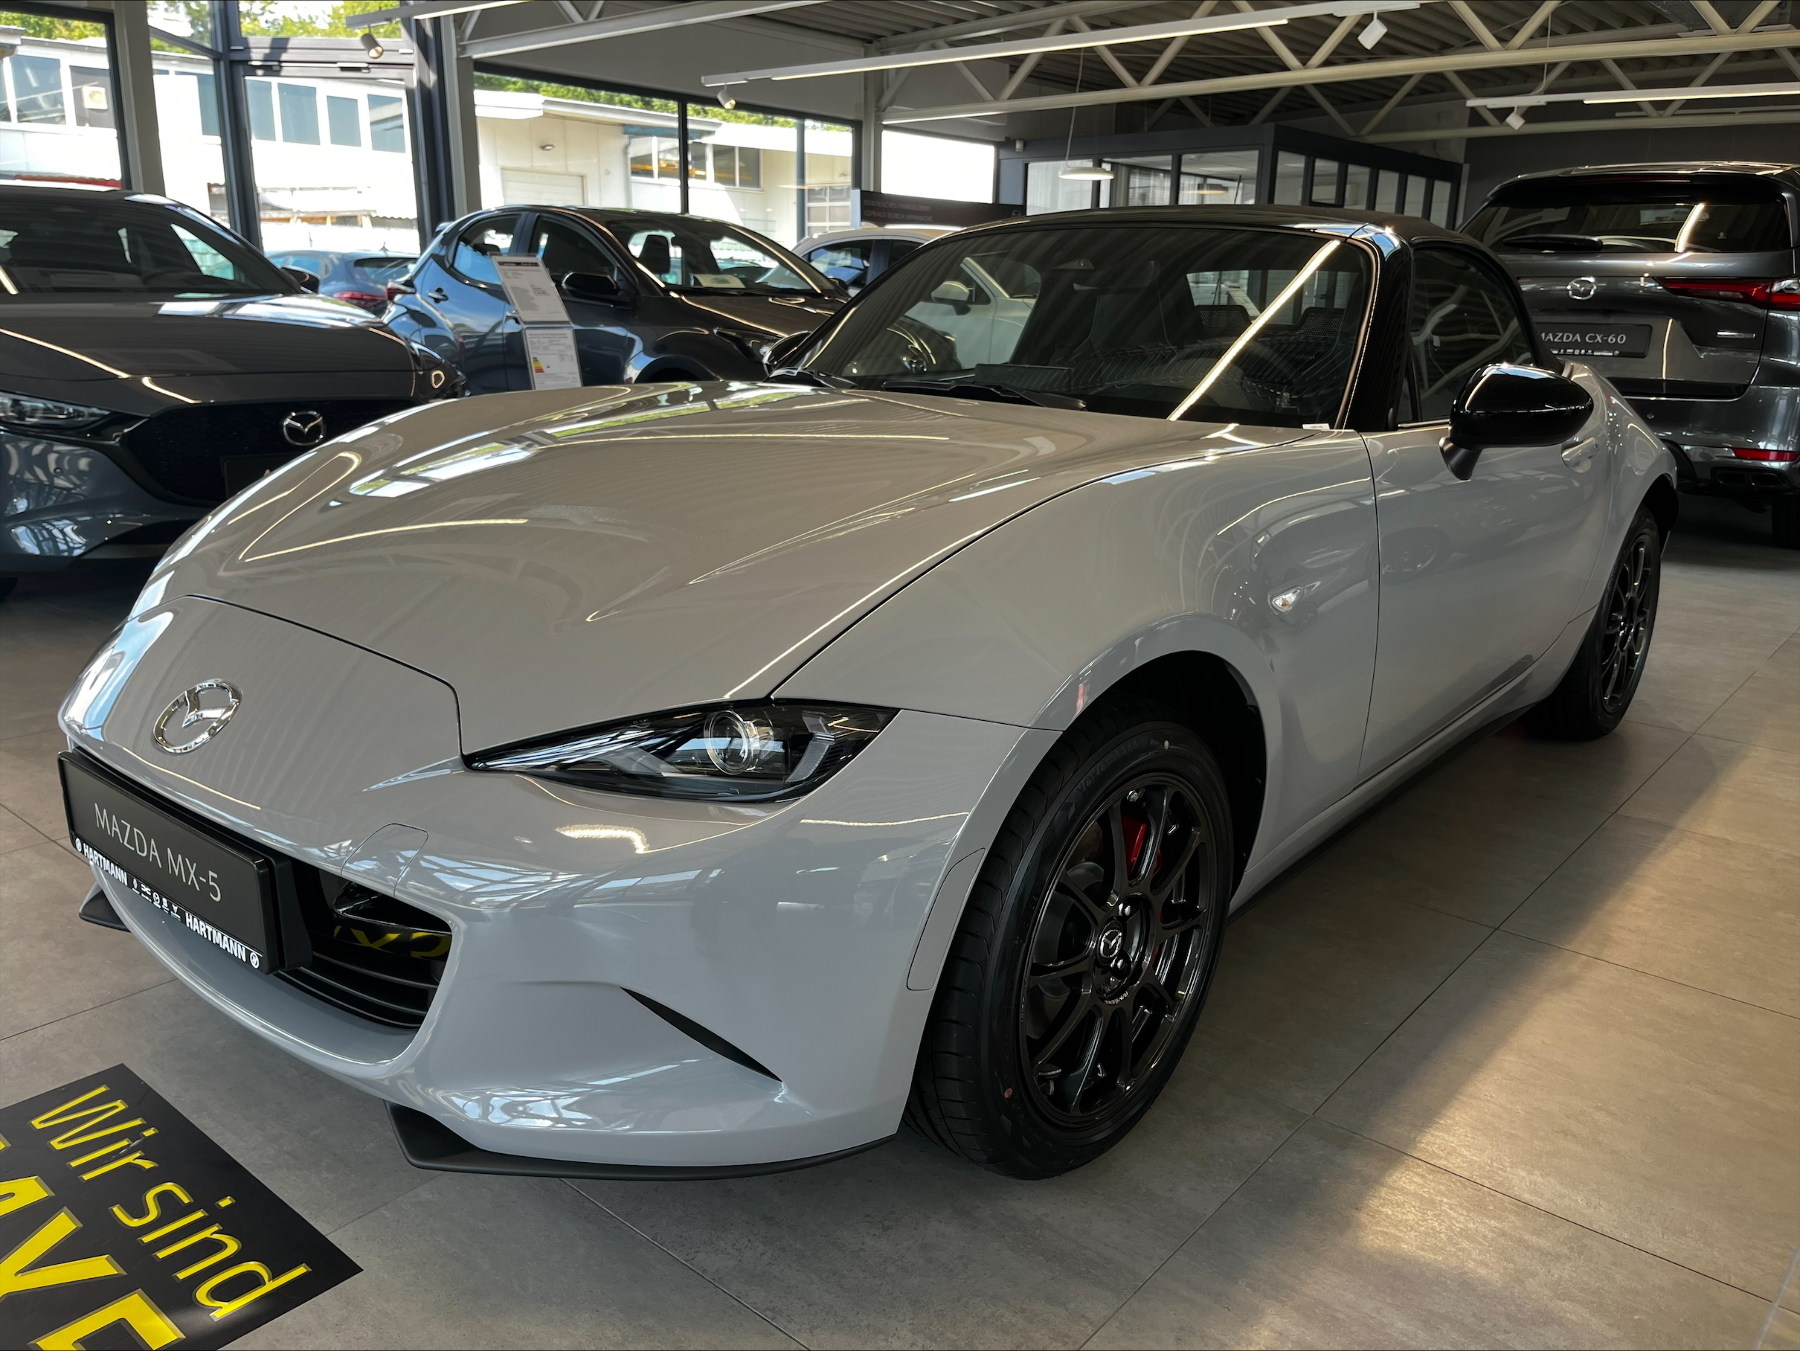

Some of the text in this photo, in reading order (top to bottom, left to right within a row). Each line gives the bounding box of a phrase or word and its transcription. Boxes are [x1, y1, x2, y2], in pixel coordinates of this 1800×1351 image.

[1585, 333, 1627, 345] CX-60
[83, 842, 128, 887] HARTMANN
[94, 802, 162, 869] MAZDA
[167, 847, 222, 902] MX-5
[185, 912, 246, 963] HARTMANN
[29, 1084, 159, 1182] Wir
[109, 1181, 312, 1321] sind
